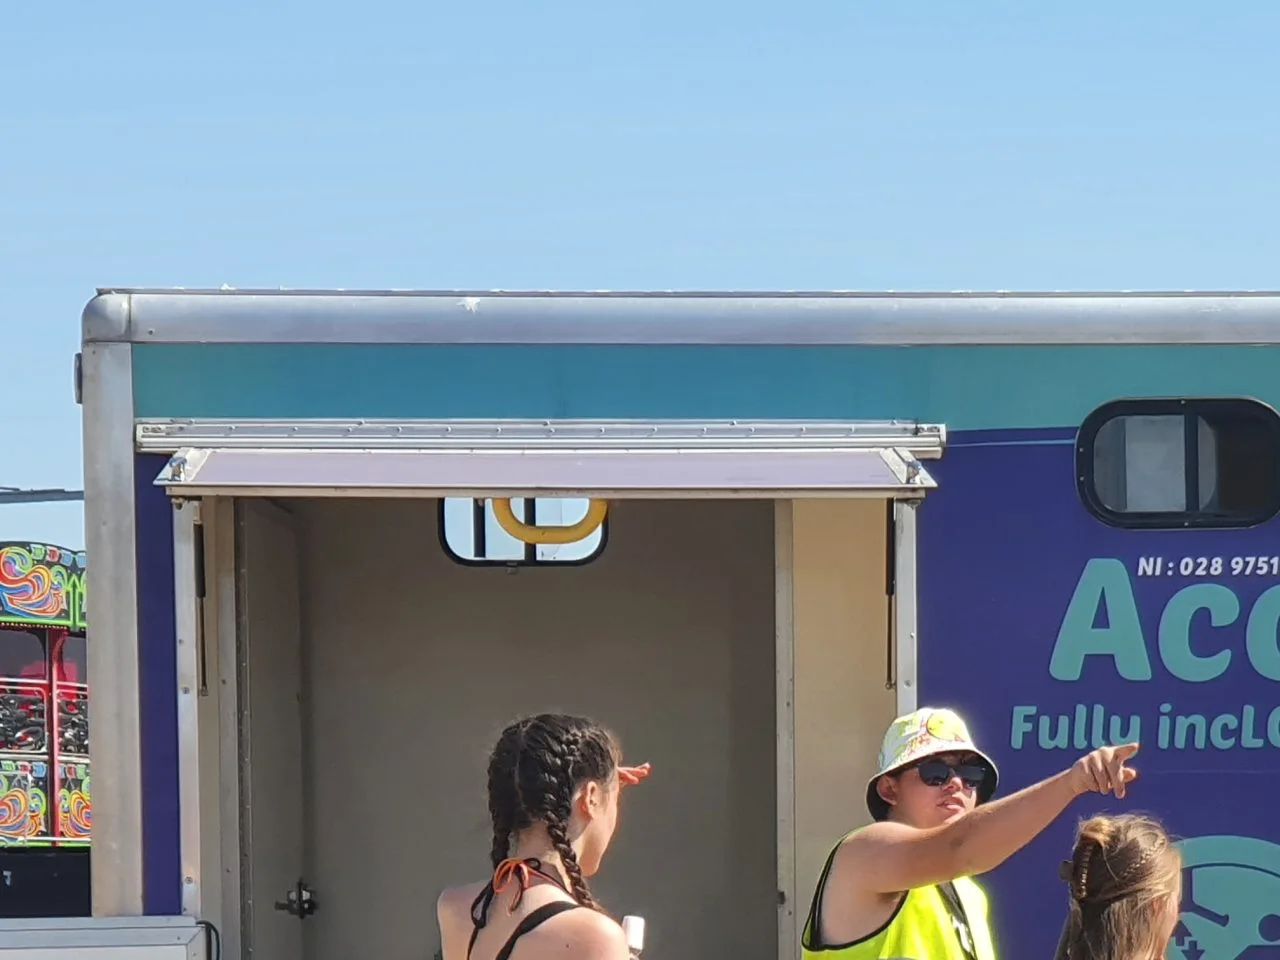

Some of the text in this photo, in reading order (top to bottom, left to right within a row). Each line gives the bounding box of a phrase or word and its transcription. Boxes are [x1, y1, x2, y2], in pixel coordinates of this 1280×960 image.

[1137, 556, 1163, 576] NI
[1179, 556, 1223, 576] 028
[1230, 556, 1280, 576] 9751
[1011, 703, 1141, 757] Fully
